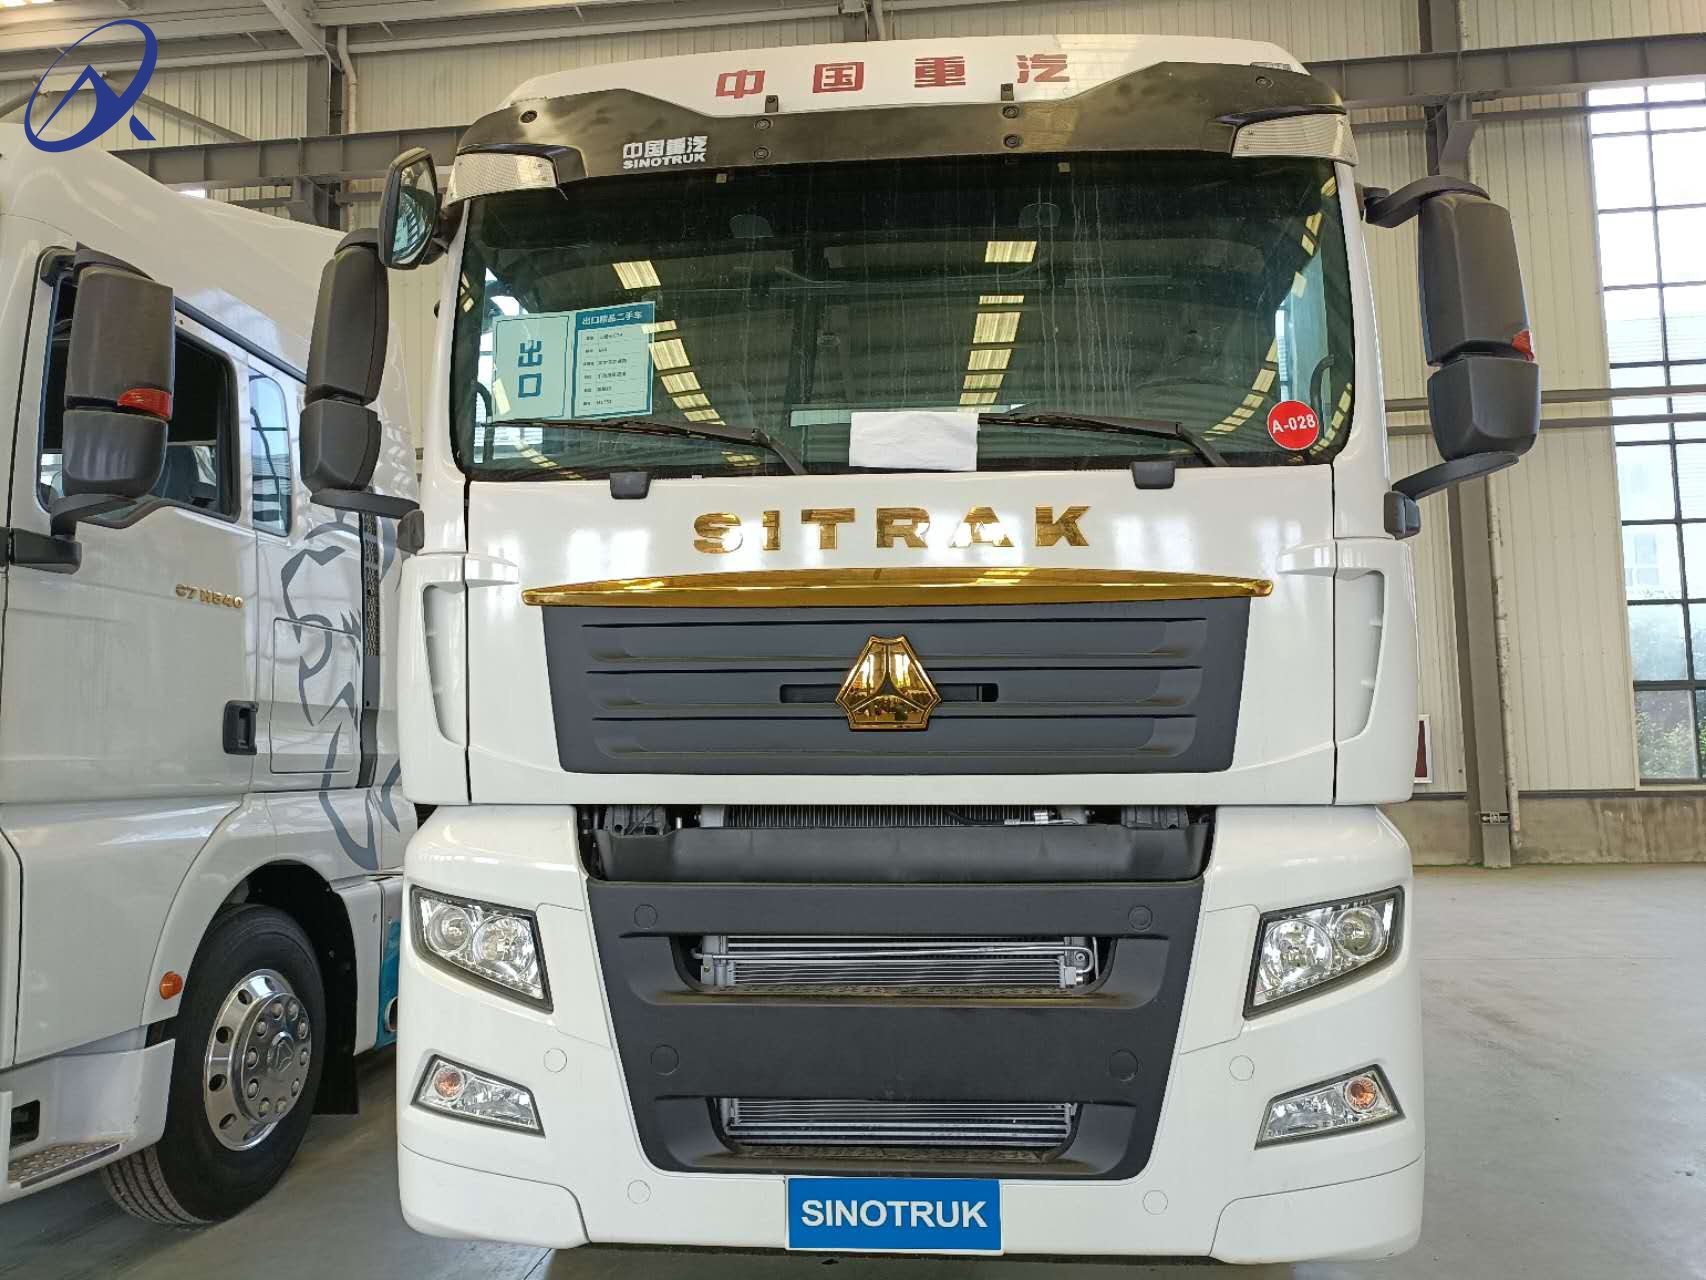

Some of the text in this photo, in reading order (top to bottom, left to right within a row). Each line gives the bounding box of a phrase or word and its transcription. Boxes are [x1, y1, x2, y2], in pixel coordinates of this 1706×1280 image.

[715, 53, 1071, 99] 中国重汽
[623, 135, 708, 159] 中国重汽
[623, 153, 706, 169] SINOTRUK
[517, 339, 543, 399] 出口
[1272, 413, 1316, 434] A-028
[693, 505, 1091, 554] SITRAK
[801, 1199, 988, 1228] SINOTRUK
